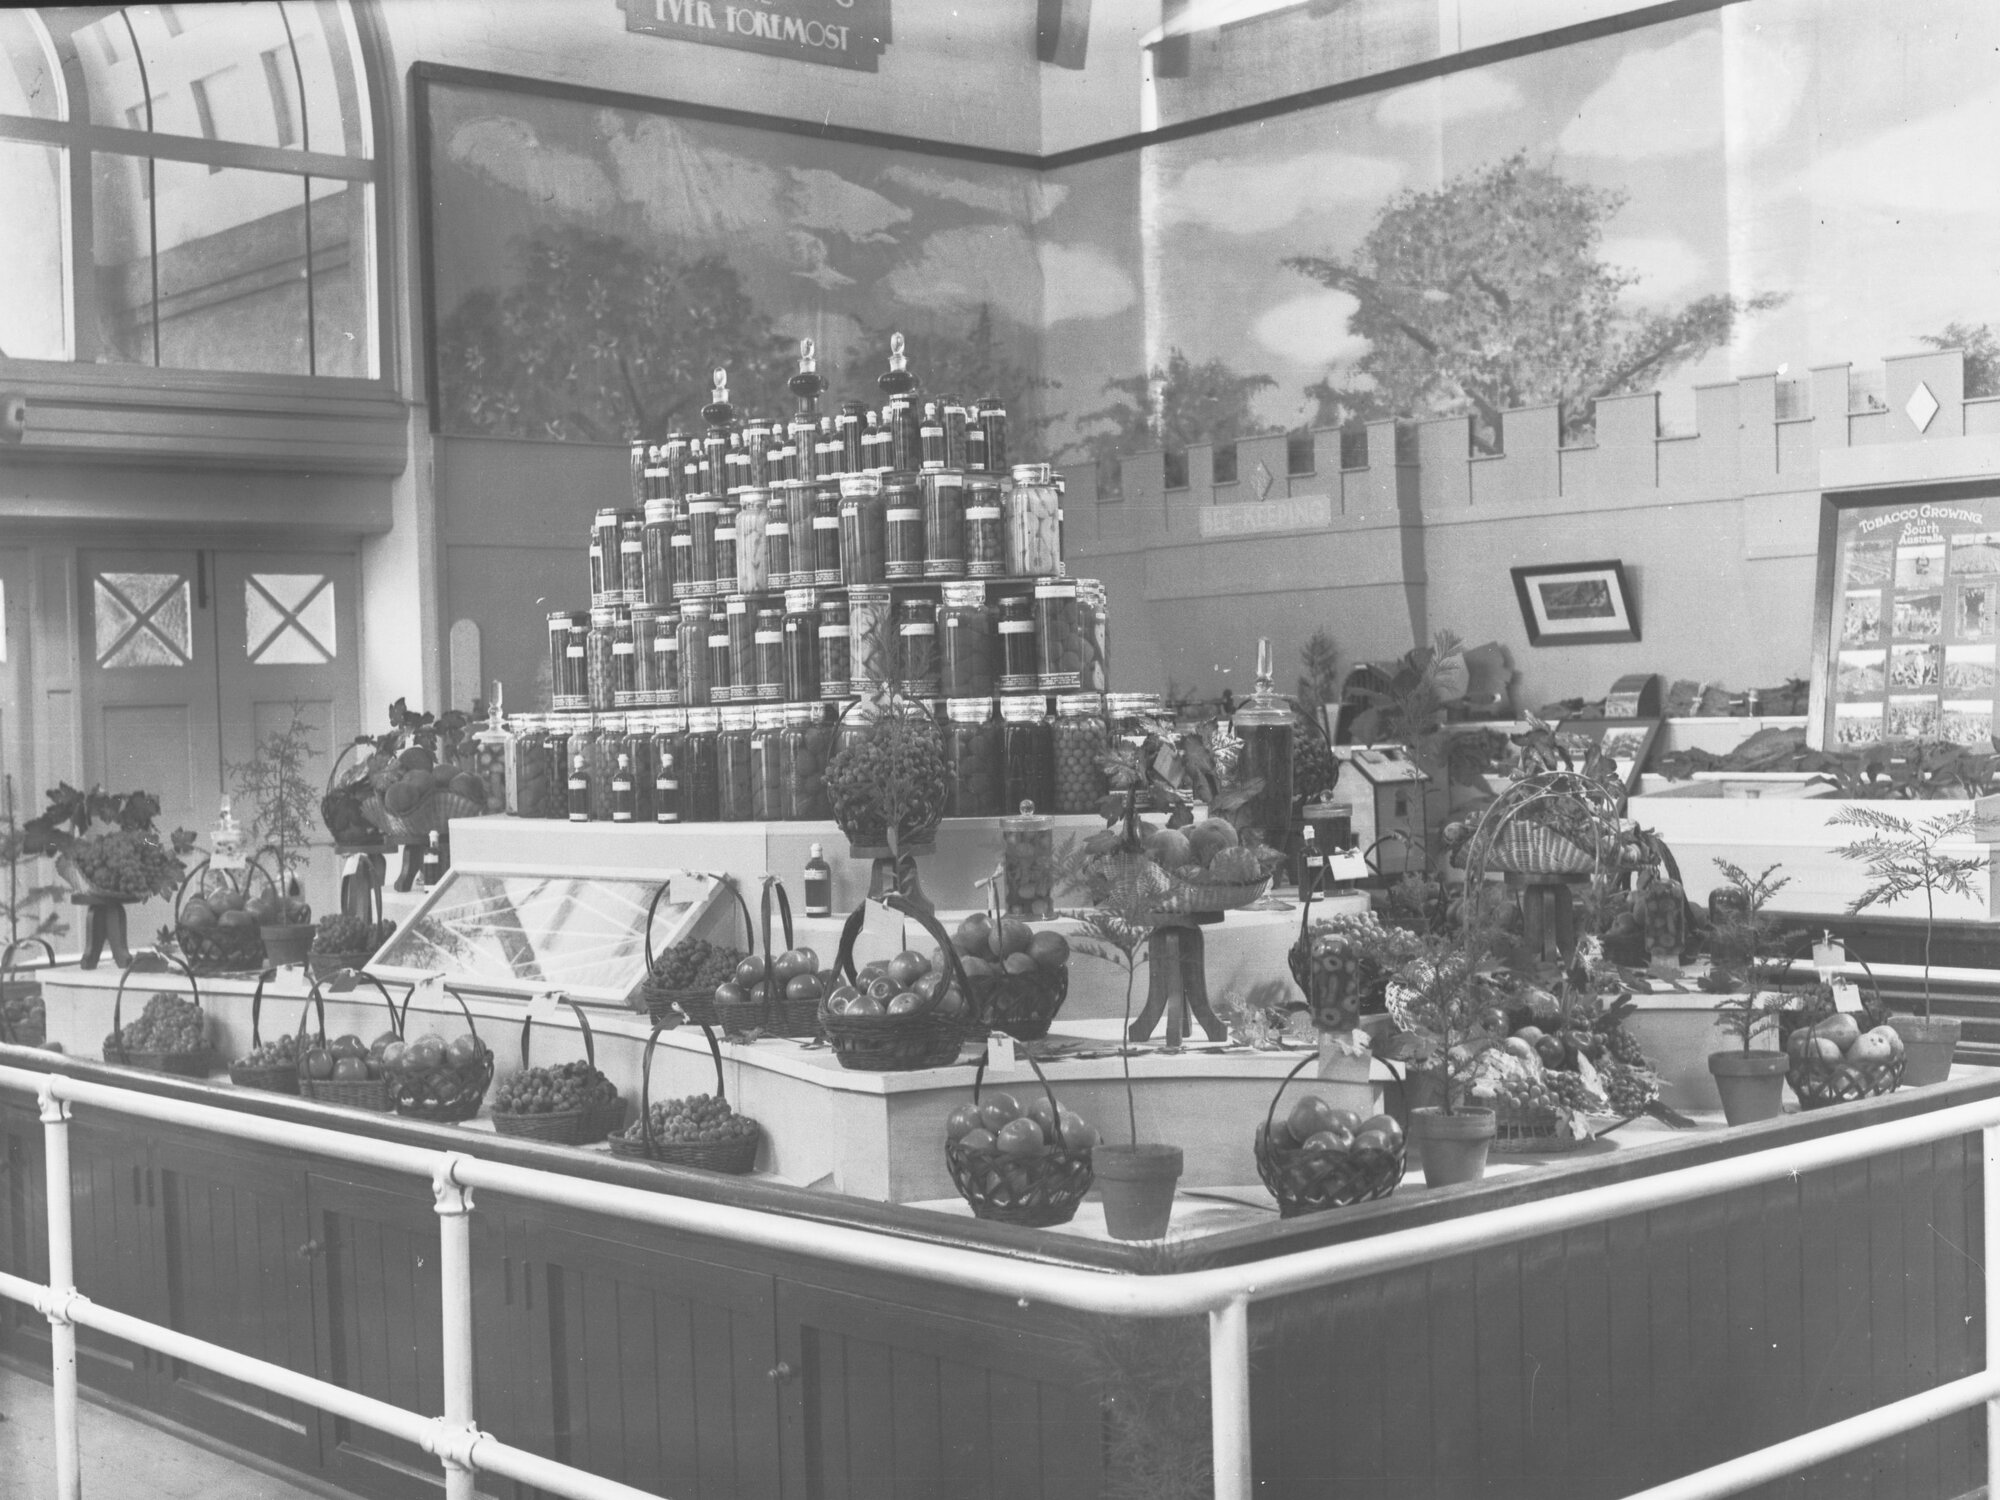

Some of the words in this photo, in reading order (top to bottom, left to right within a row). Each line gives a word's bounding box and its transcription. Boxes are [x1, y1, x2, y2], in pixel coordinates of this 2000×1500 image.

[725, 6, 849, 50] FOREMOST
[1202, 500, 1325, 533] BEE-KEEPING
[1859, 509, 1918, 534] TOBACCO
[1920, 504, 1983, 525] GROWING
[1903, 521, 1939, 536] South
